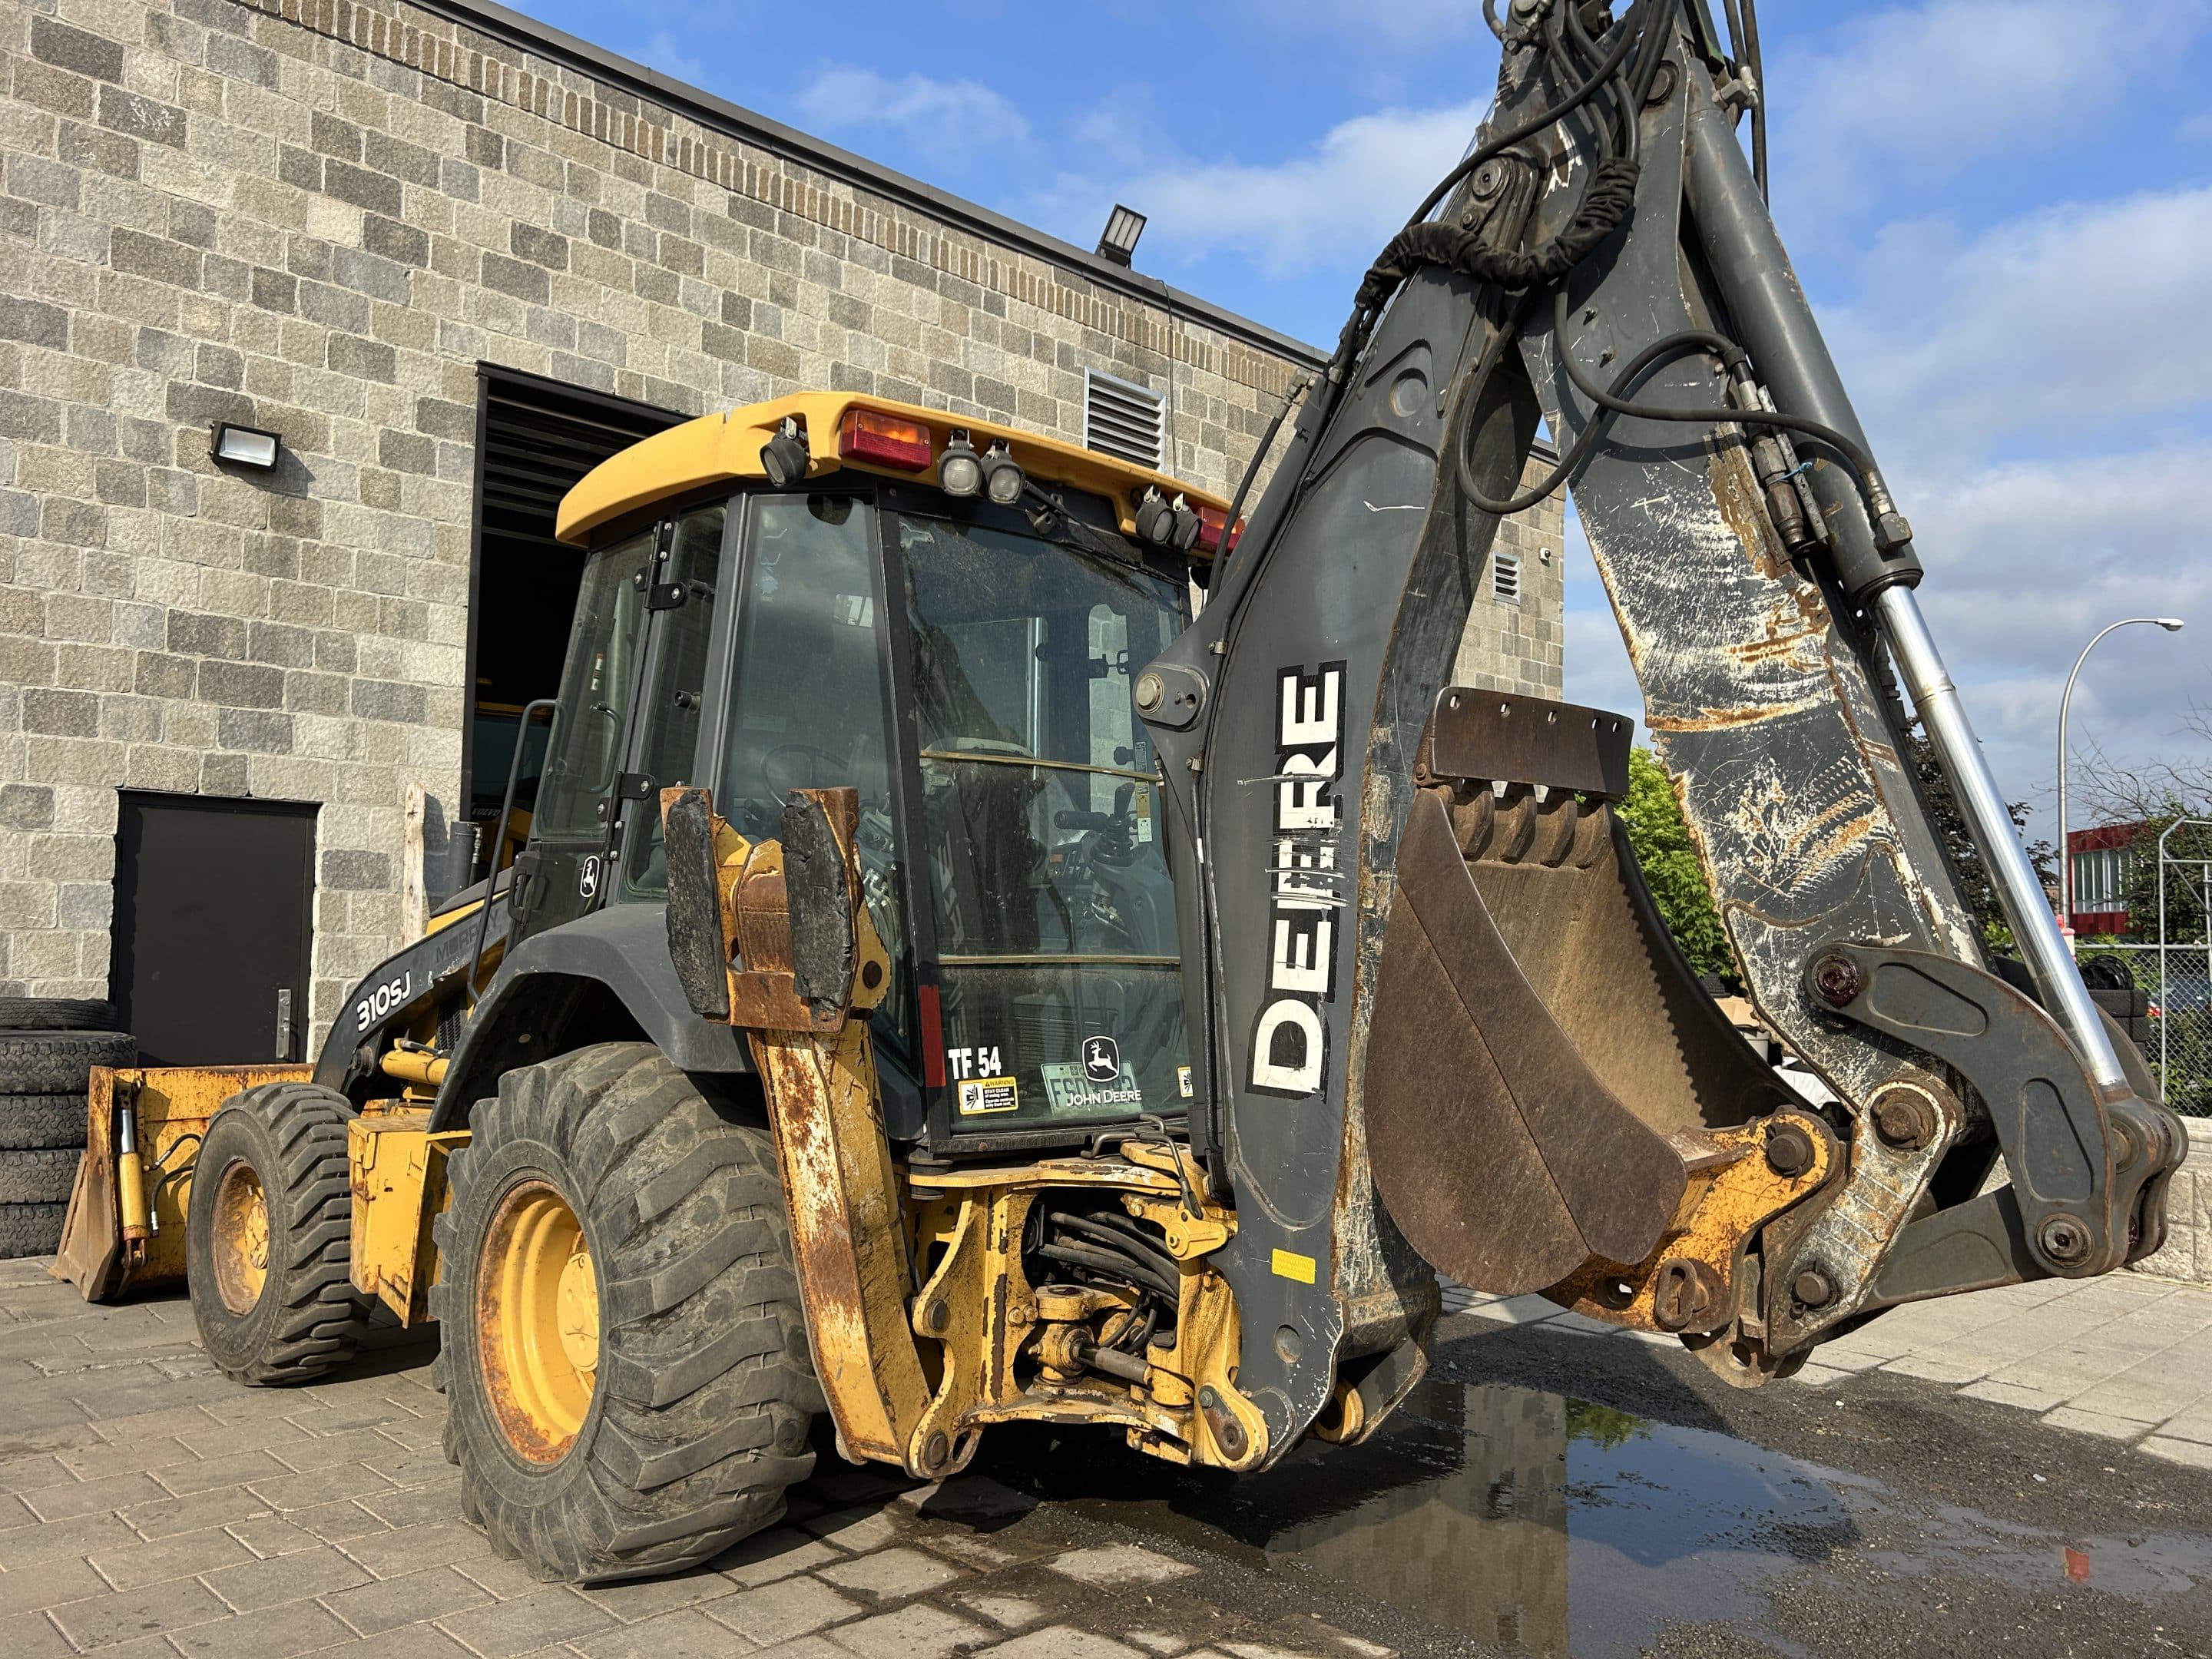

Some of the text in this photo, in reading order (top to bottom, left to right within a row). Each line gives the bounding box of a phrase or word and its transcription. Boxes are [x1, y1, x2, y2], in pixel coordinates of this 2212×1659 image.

[1252, 670, 1339, 1094] DEERE
[356, 969, 412, 1032] 310SJ
[948, 1046, 1002, 1080] TF 54
[1066, 1092, 1101, 1107] JOHN
[1103, 1089, 1142, 1103] DEERE
